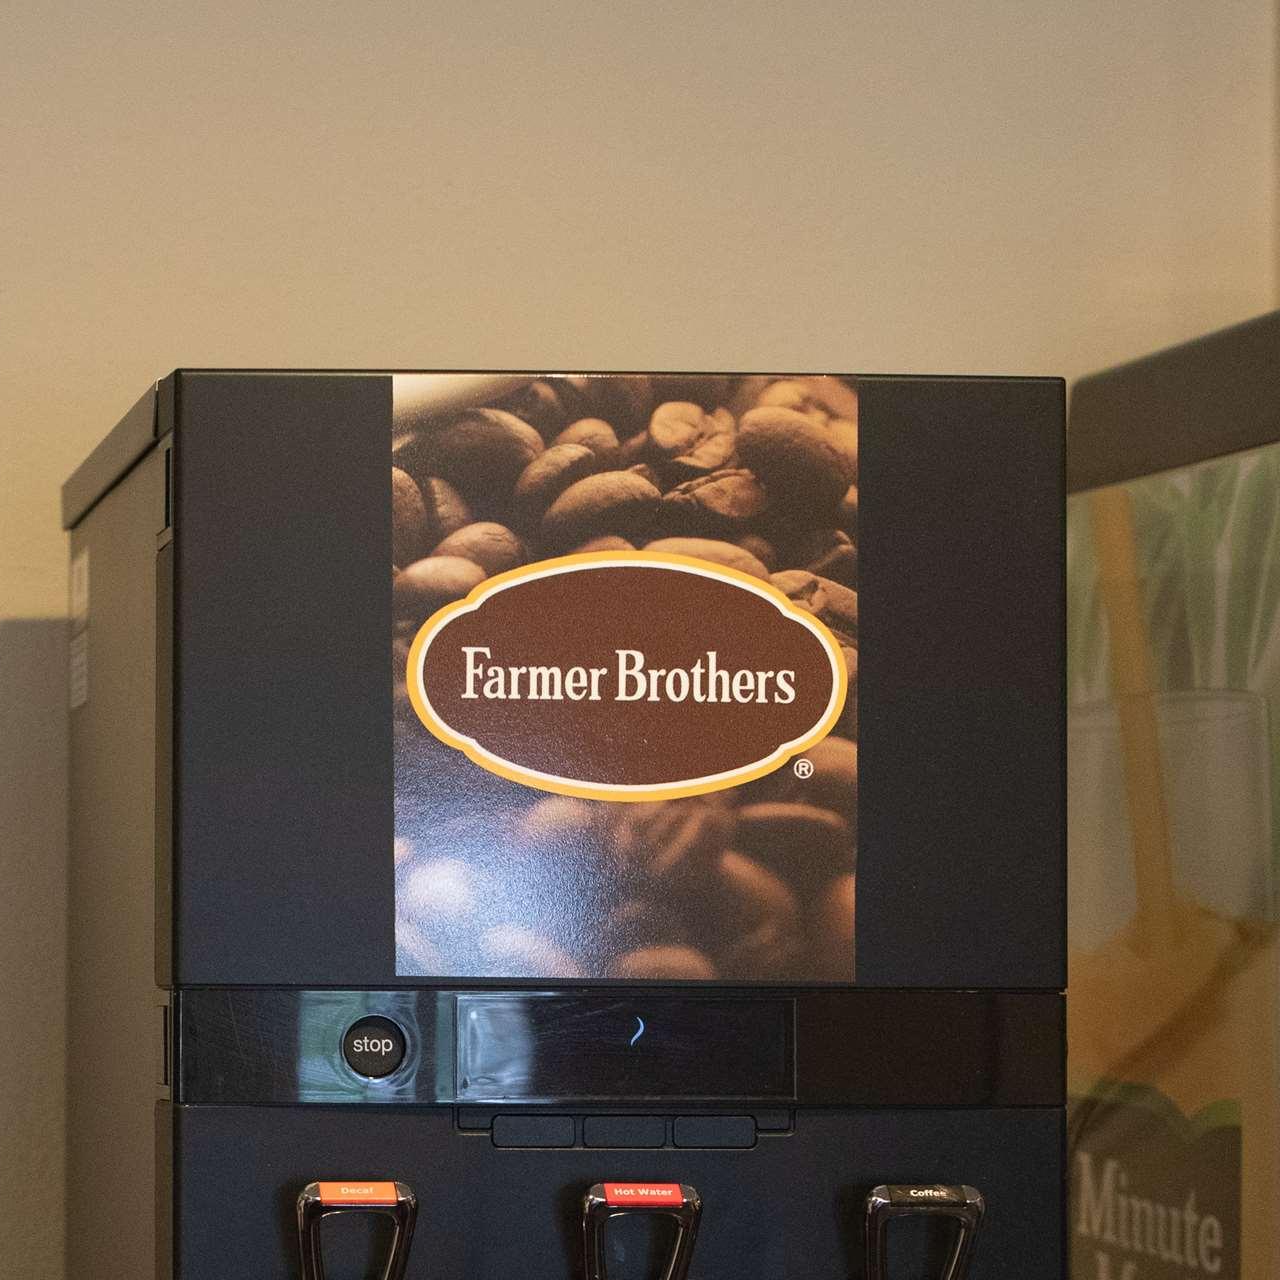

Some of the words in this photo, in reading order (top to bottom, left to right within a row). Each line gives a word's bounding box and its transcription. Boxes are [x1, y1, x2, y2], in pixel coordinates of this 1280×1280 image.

[460, 645, 607, 702] Farmer
[616, 648, 797, 706] Brothers
[353, 1036, 393, 1056] stop
[340, 1186, 374, 1195] Decaf
[614, 1187, 635, 1196] Hot
[640, 1187, 673, 1196] Water
[910, 1189, 948, 1197] Coffee
[1076, 1150, 1223, 1273] Minute
